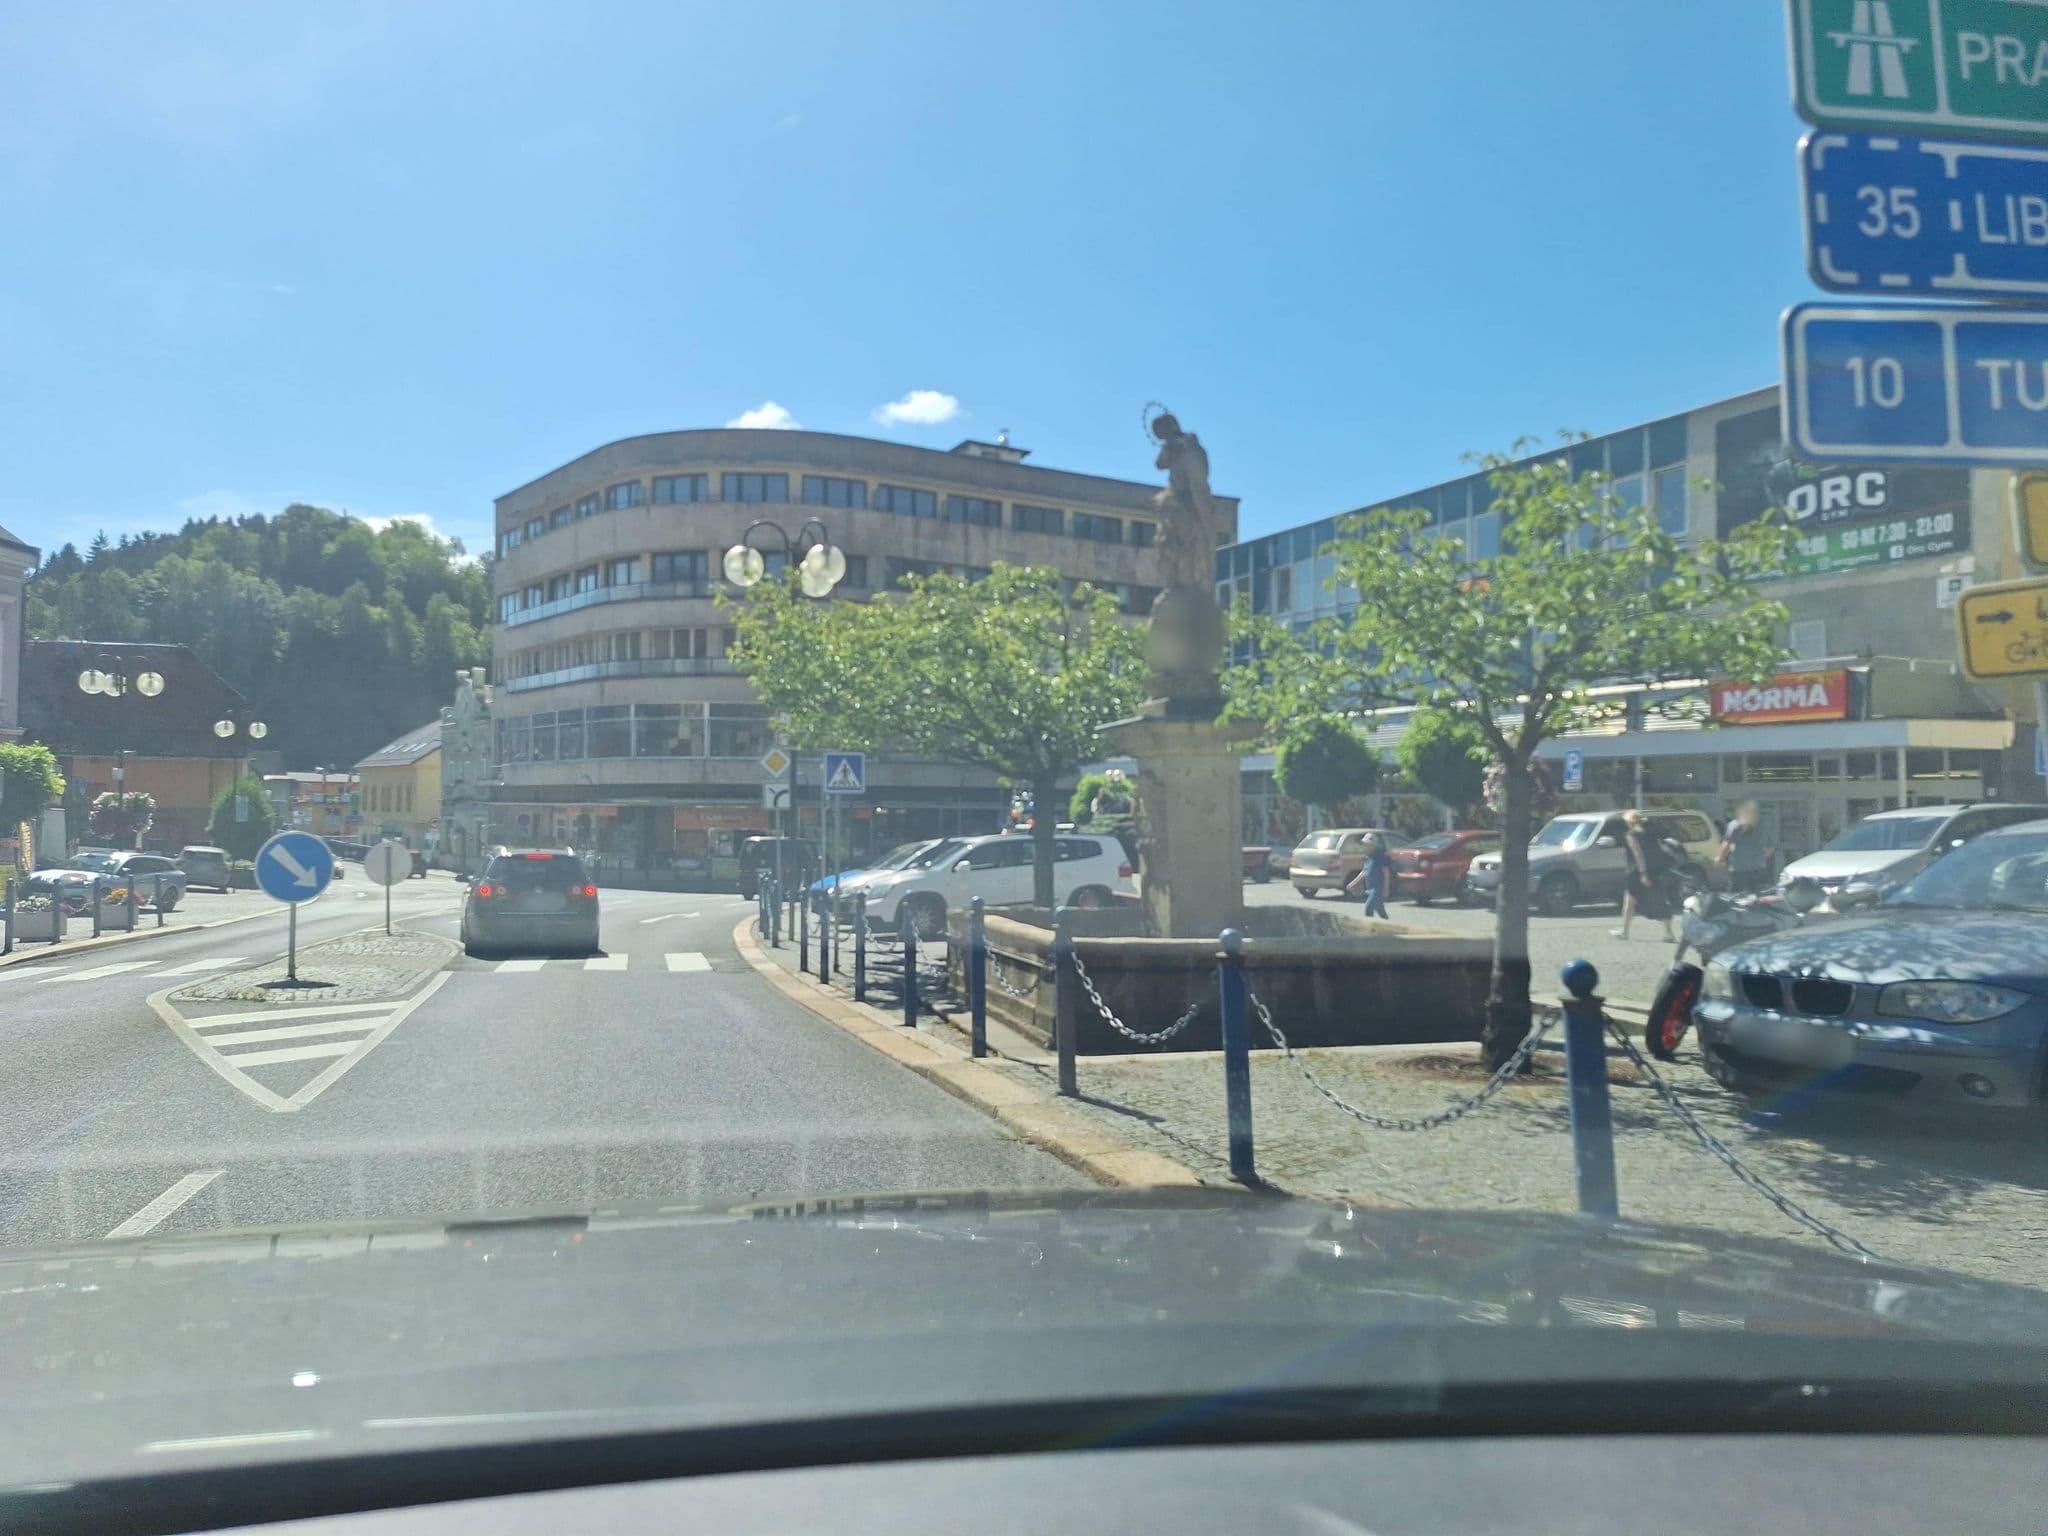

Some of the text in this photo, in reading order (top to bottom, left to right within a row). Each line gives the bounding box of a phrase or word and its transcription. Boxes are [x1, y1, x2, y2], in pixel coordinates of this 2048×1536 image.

[1857, 185, 2048, 246] 35 LIB
[1846, 356, 2048, 411] 10 TU
[1787, 472, 1885, 520] ORC
[1722, 683, 1829, 712] NORMA
